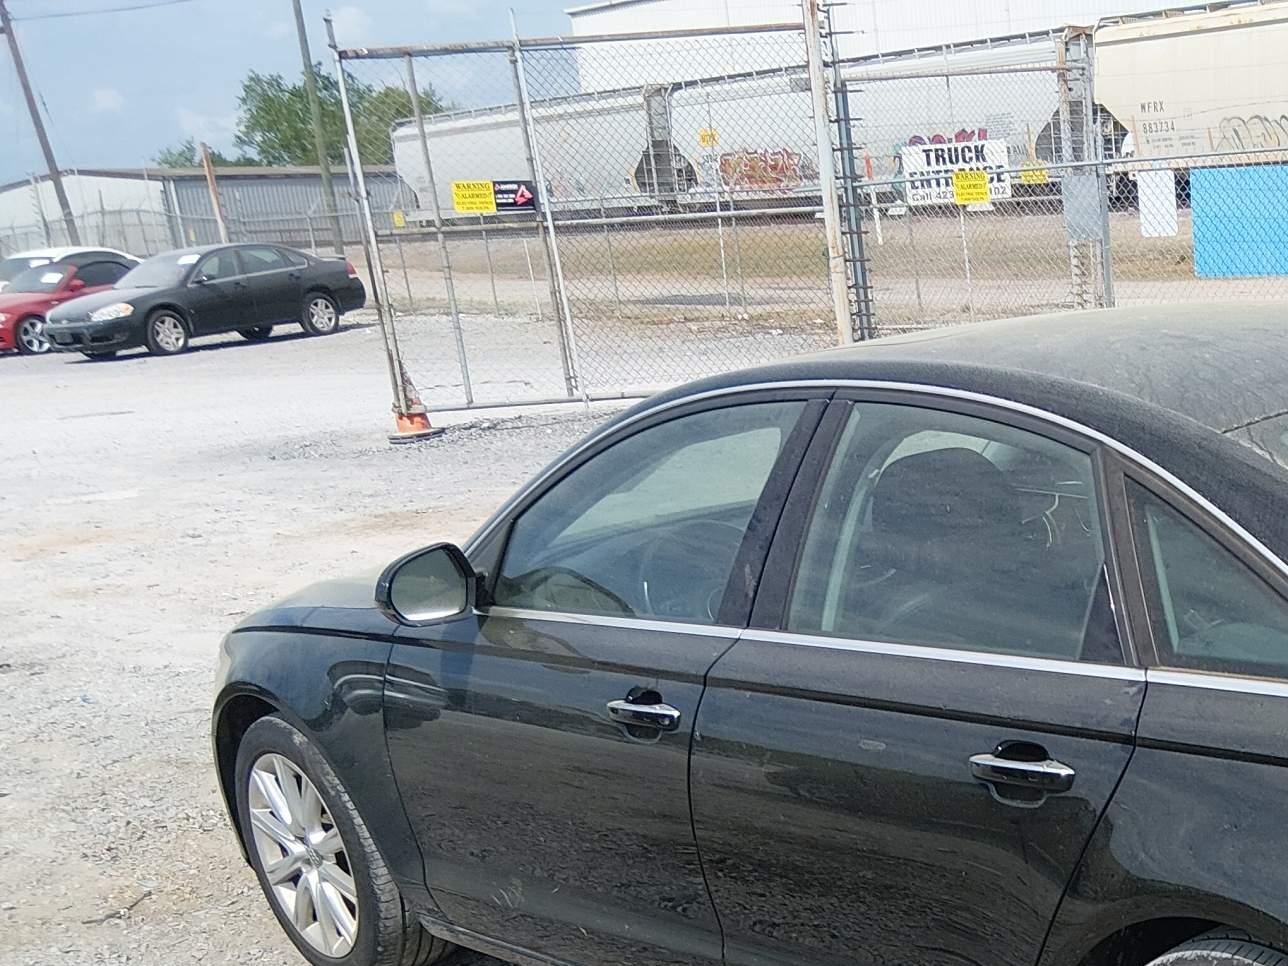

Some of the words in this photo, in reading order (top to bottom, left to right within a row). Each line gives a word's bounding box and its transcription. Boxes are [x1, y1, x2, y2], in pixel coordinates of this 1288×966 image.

[922, 143, 987, 167] TRUCK
[955, 172, 986, 181] WARNING
[454, 182, 490, 190] WARNING
[911, 191, 932, 202] Call
